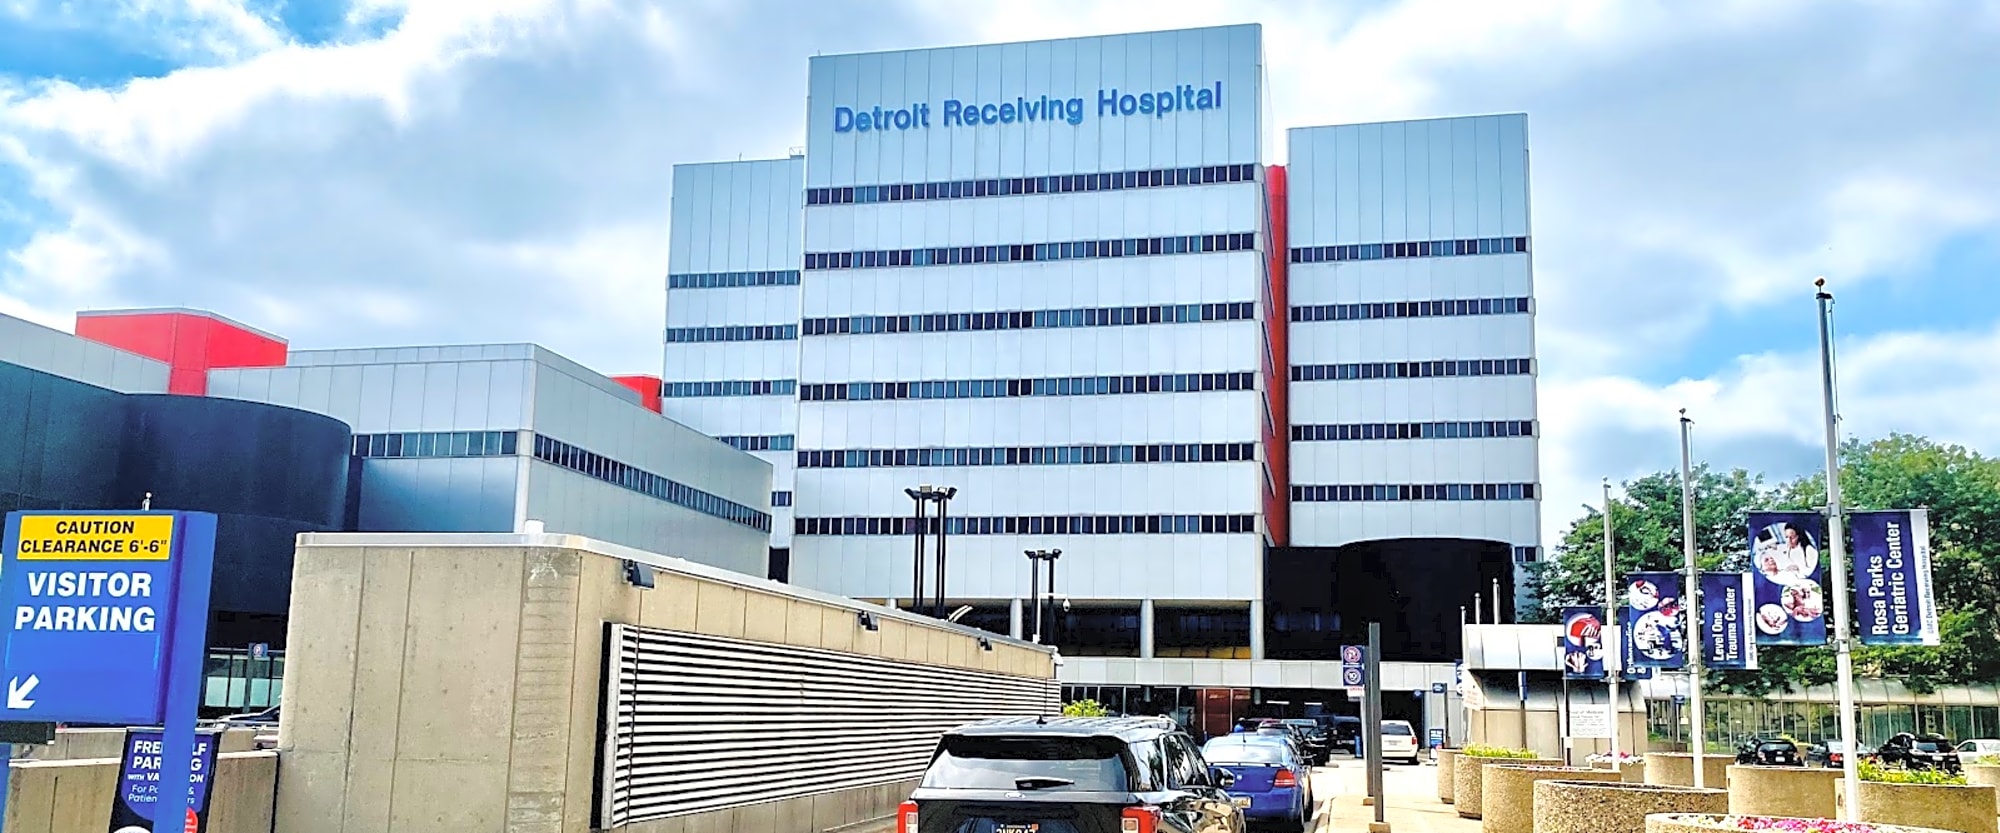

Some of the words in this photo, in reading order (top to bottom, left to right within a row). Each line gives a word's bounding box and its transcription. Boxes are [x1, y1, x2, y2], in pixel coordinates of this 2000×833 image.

[834, 103, 930, 133] Detroit
[943, 95, 1084, 126] Receiving
[1097, 81, 1222, 118] Hospital
[56, 521, 135, 534] CAUTION
[20, 540, 124, 553] CLEARANCE
[129, 539, 168, 553] 6'-6"
[1885, 521, 1903, 569] Center
[28, 572, 152, 597] VISITOR
[1866, 555, 1886, 597] Parks
[15, 606, 155, 632] PARKING
[1724, 587, 1737, 621] Center
[1871, 600, 1889, 635] Rosa
[1888, 572, 1909, 635] Geriatric
[1711, 612, 1723, 632] One
[1711, 633, 1724, 661] Level
[1726, 622, 1738, 661] Trauma
[133, 740, 163, 754] FRE
